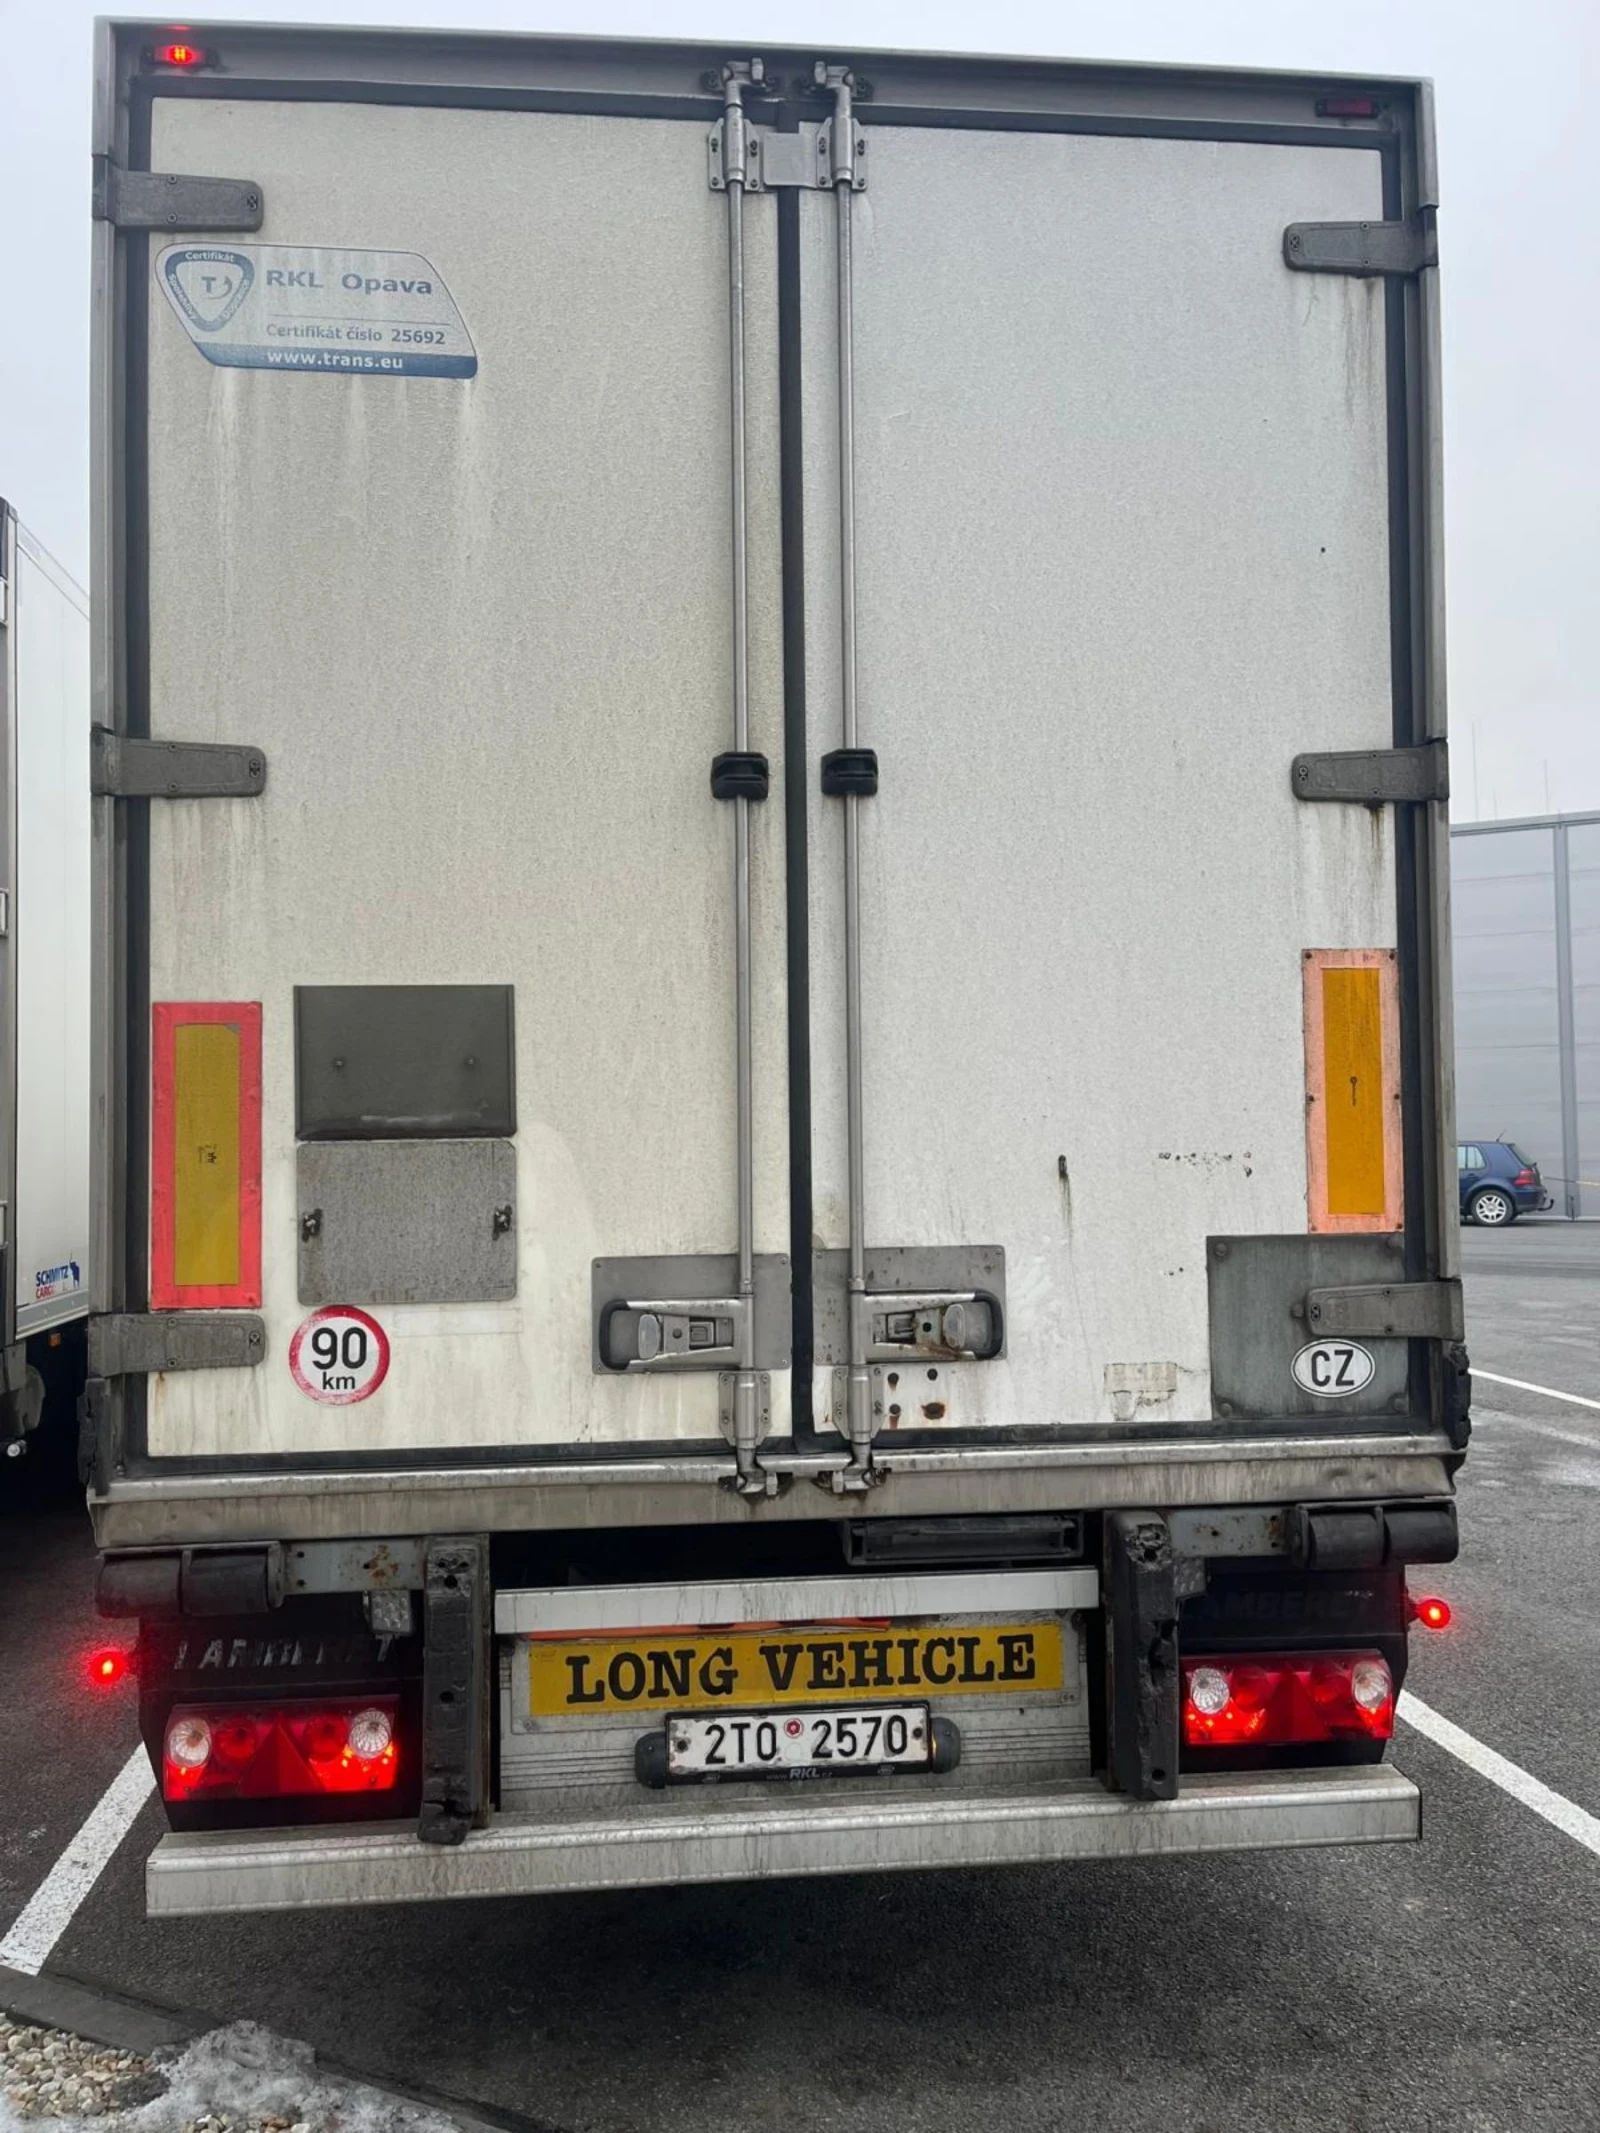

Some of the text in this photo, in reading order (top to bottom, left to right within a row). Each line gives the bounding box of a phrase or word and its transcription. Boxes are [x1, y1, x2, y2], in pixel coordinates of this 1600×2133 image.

[266, 270, 432, 295] RKL Opava
[266, 323, 342, 340] Certifikát
[391, 329, 446, 344] 25692
[267, 351, 404, 369] www.trans.eu
[311, 1327, 367, 1370] 90
[322, 1371, 356, 1390] km
[1311, 1349, 1354, 1386] CZ
[566, 1634, 1035, 1704] LONG VEHICLE
[811, 1715, 907, 1759] 2570
